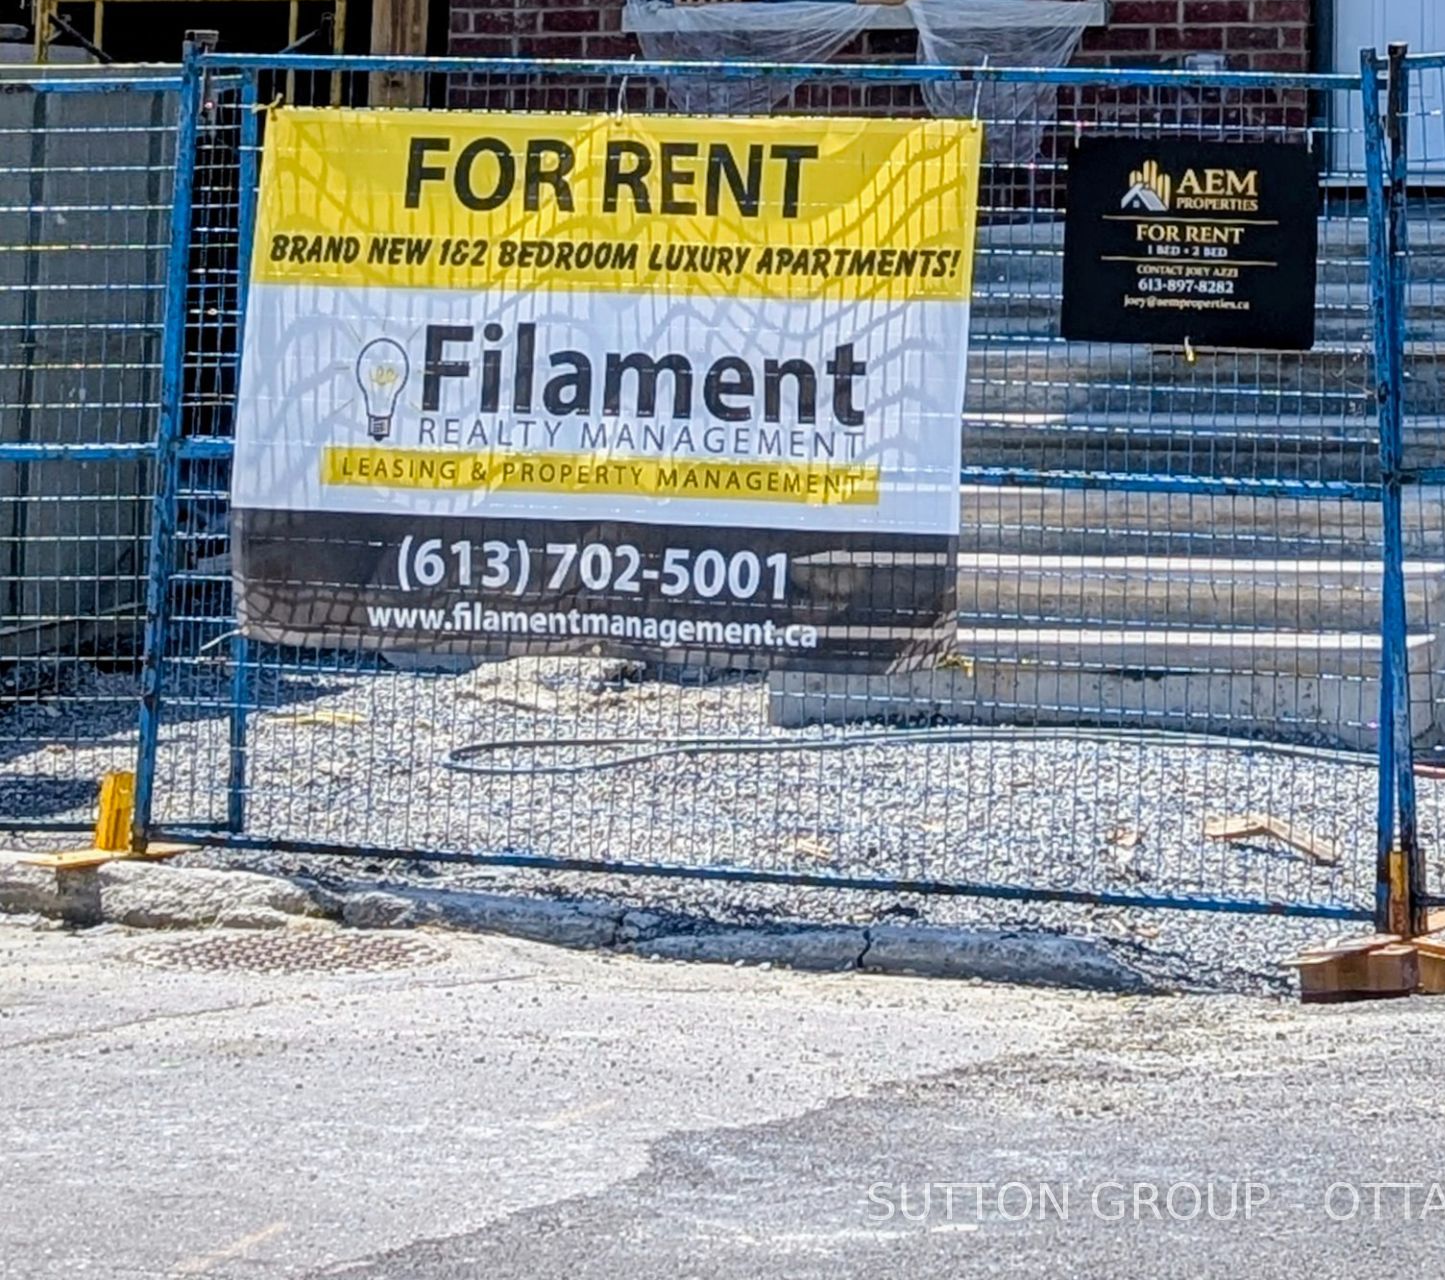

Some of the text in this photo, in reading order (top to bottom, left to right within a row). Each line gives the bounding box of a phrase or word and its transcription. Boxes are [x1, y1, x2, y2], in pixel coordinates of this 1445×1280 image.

[404, 137, 819, 218] FOR RENT
[1176, 169, 1258, 197] AEM
[1176, 197, 1258, 212] PROPERTIES
[1136, 224, 1245, 245] FOR RENT
[1156, 245, 1181, 257] BED
[1203, 246, 1228, 258] BED
[270, 235, 360, 265] BRAND
[367, 237, 431, 268] NEW
[498, 241, 638, 272] BEDROOM
[648, 244, 750, 277] LUXURY
[755, 247, 960, 279] APARTMENTS!
[1136, 264, 1183, 275] CONTACT
[1137, 278, 1234, 294] 613-897-8282
[421, 322, 867, 427] Filament
[420, 418, 864, 460] REALTY MANAGEMENT
[341, 457, 860, 496] LEASING & PROPERTY MANAGEMENT
[397, 535, 790, 602] (613) 702-5001
[367, 602, 818, 649] www.filamentmanagement.ca
